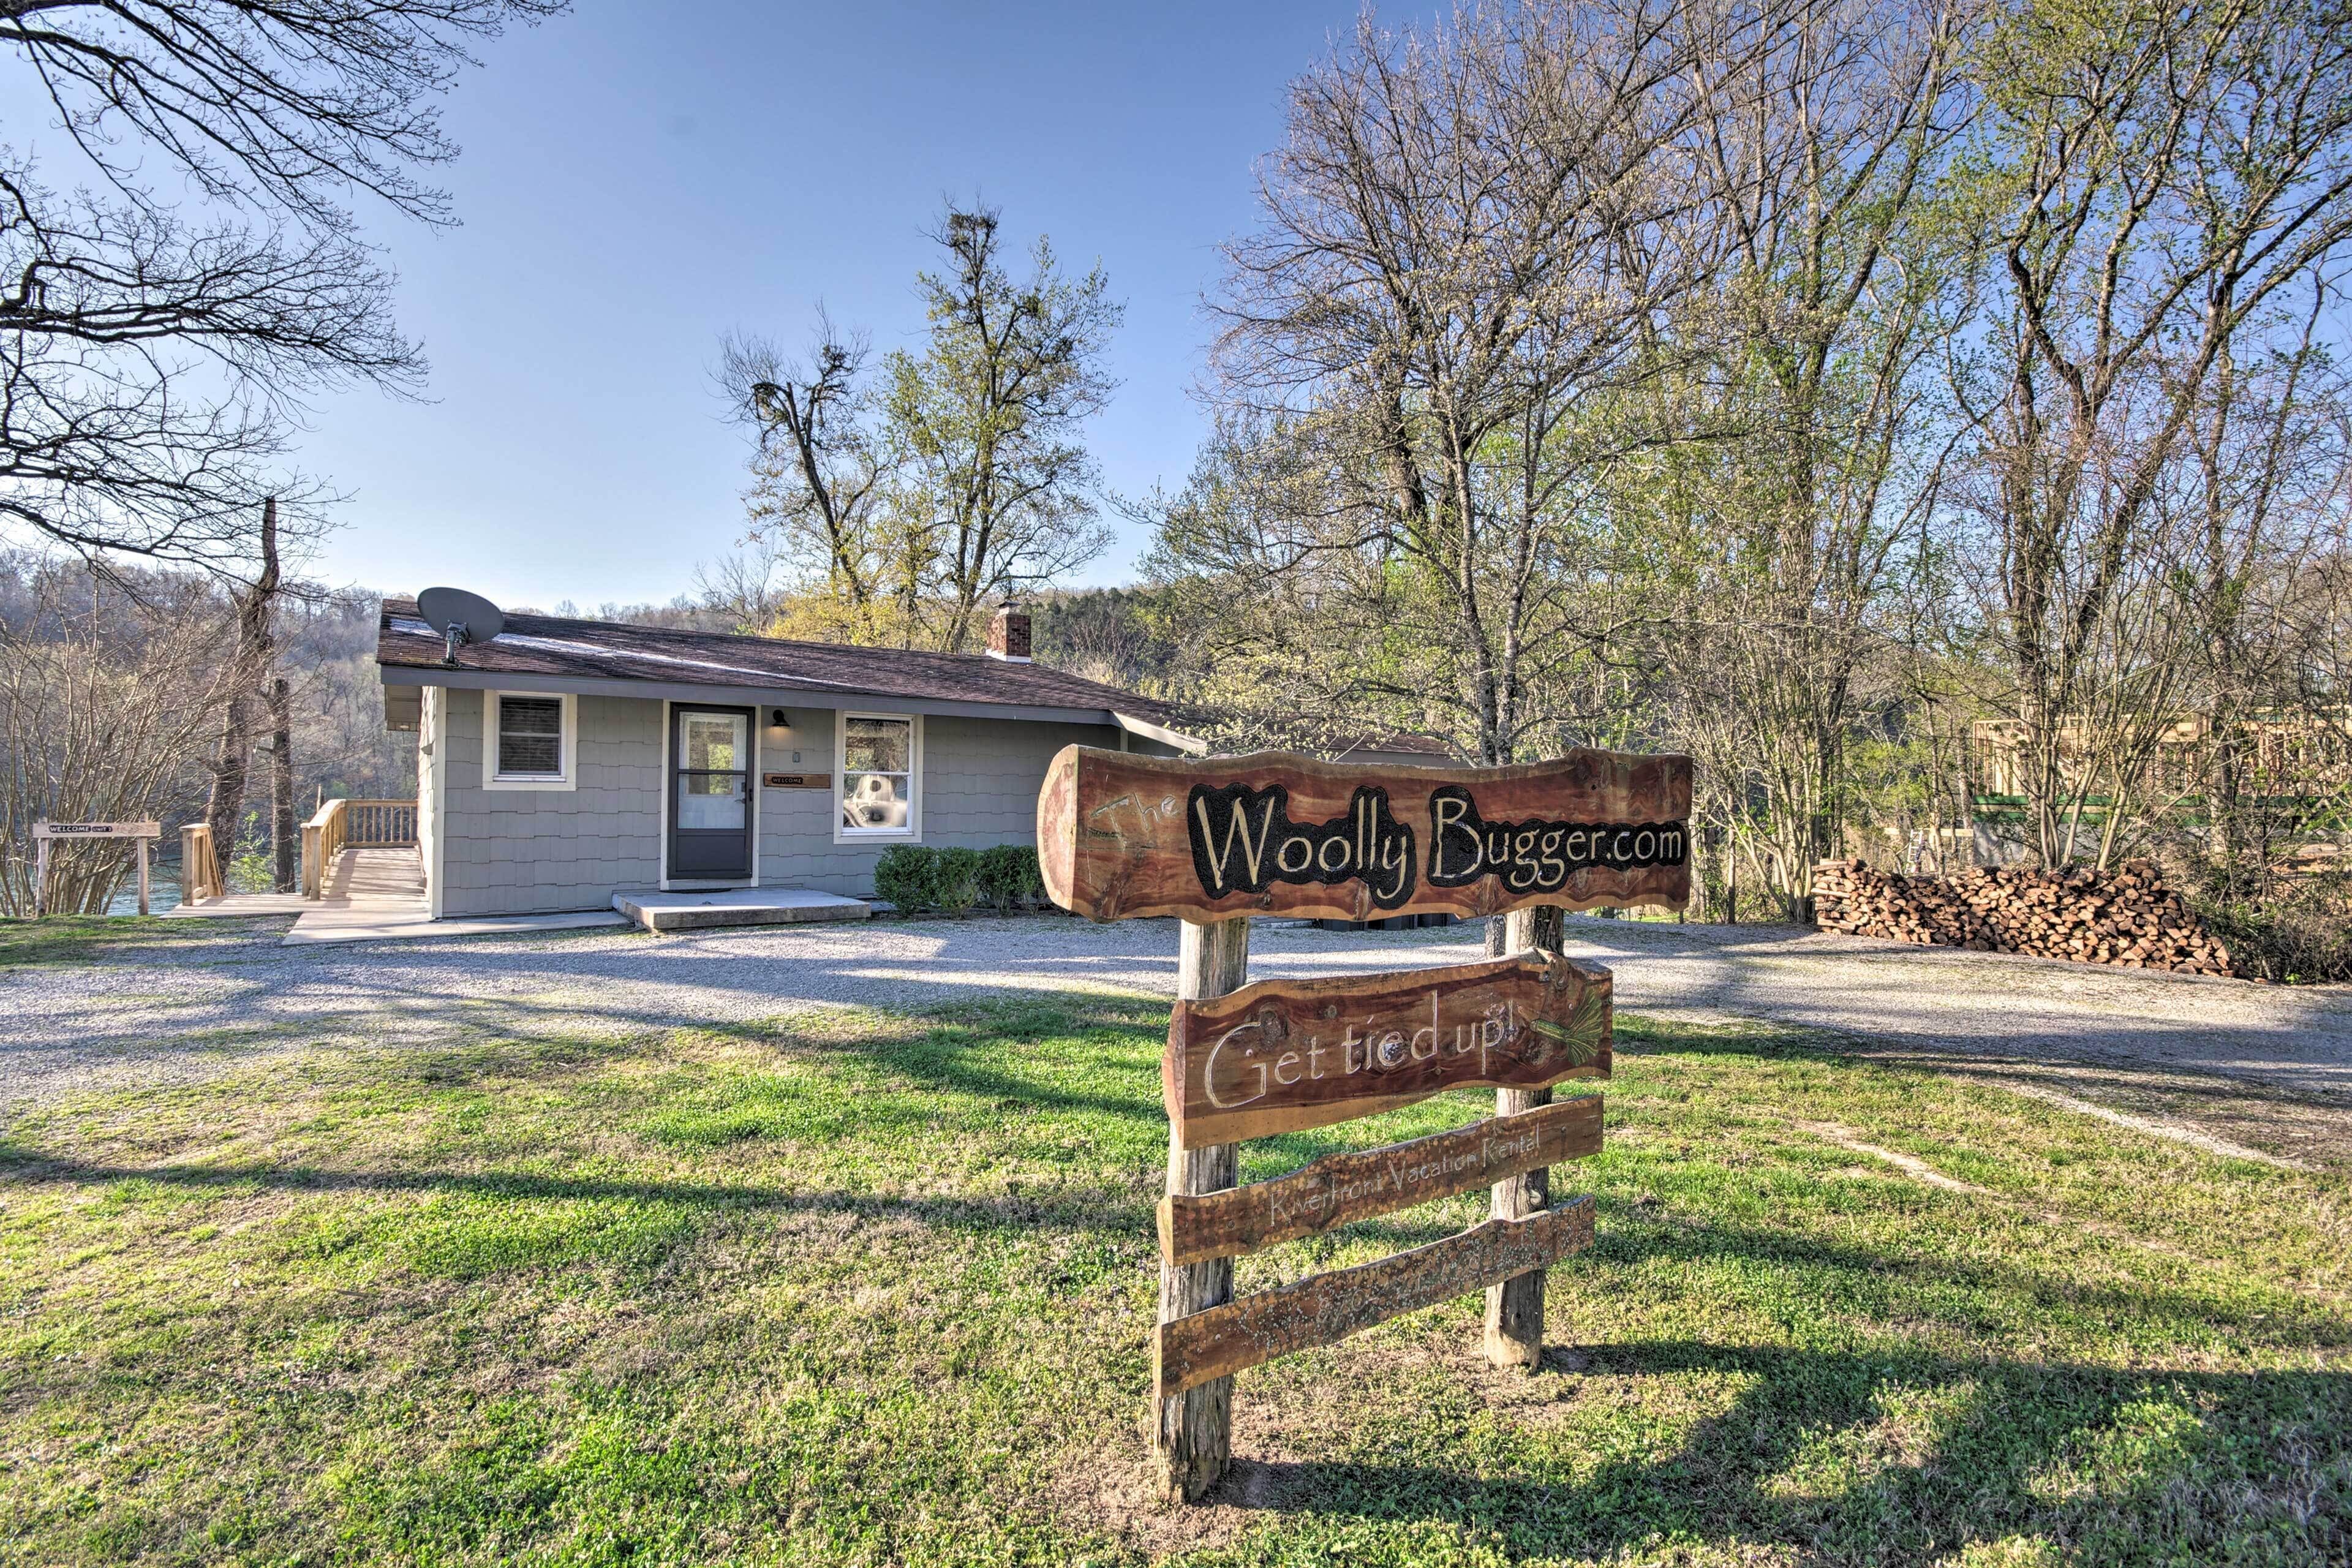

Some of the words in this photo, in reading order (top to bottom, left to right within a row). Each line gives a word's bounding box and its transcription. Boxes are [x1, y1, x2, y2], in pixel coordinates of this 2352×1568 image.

[1090, 792, 1178, 850] The
[1196, 795, 1406, 899] Woolly
[1433, 797, 1683, 888] Bugger.com
[1205, 1020, 1325, 1109] Get
[1342, 989, 1438, 1075] tied
[1455, 999, 1514, 1075] up!
[1270, 1170, 1382, 1227] Riverfront
[1388, 1153, 1477, 1191] Vacation
[1482, 1123, 1539, 1167] Rental
